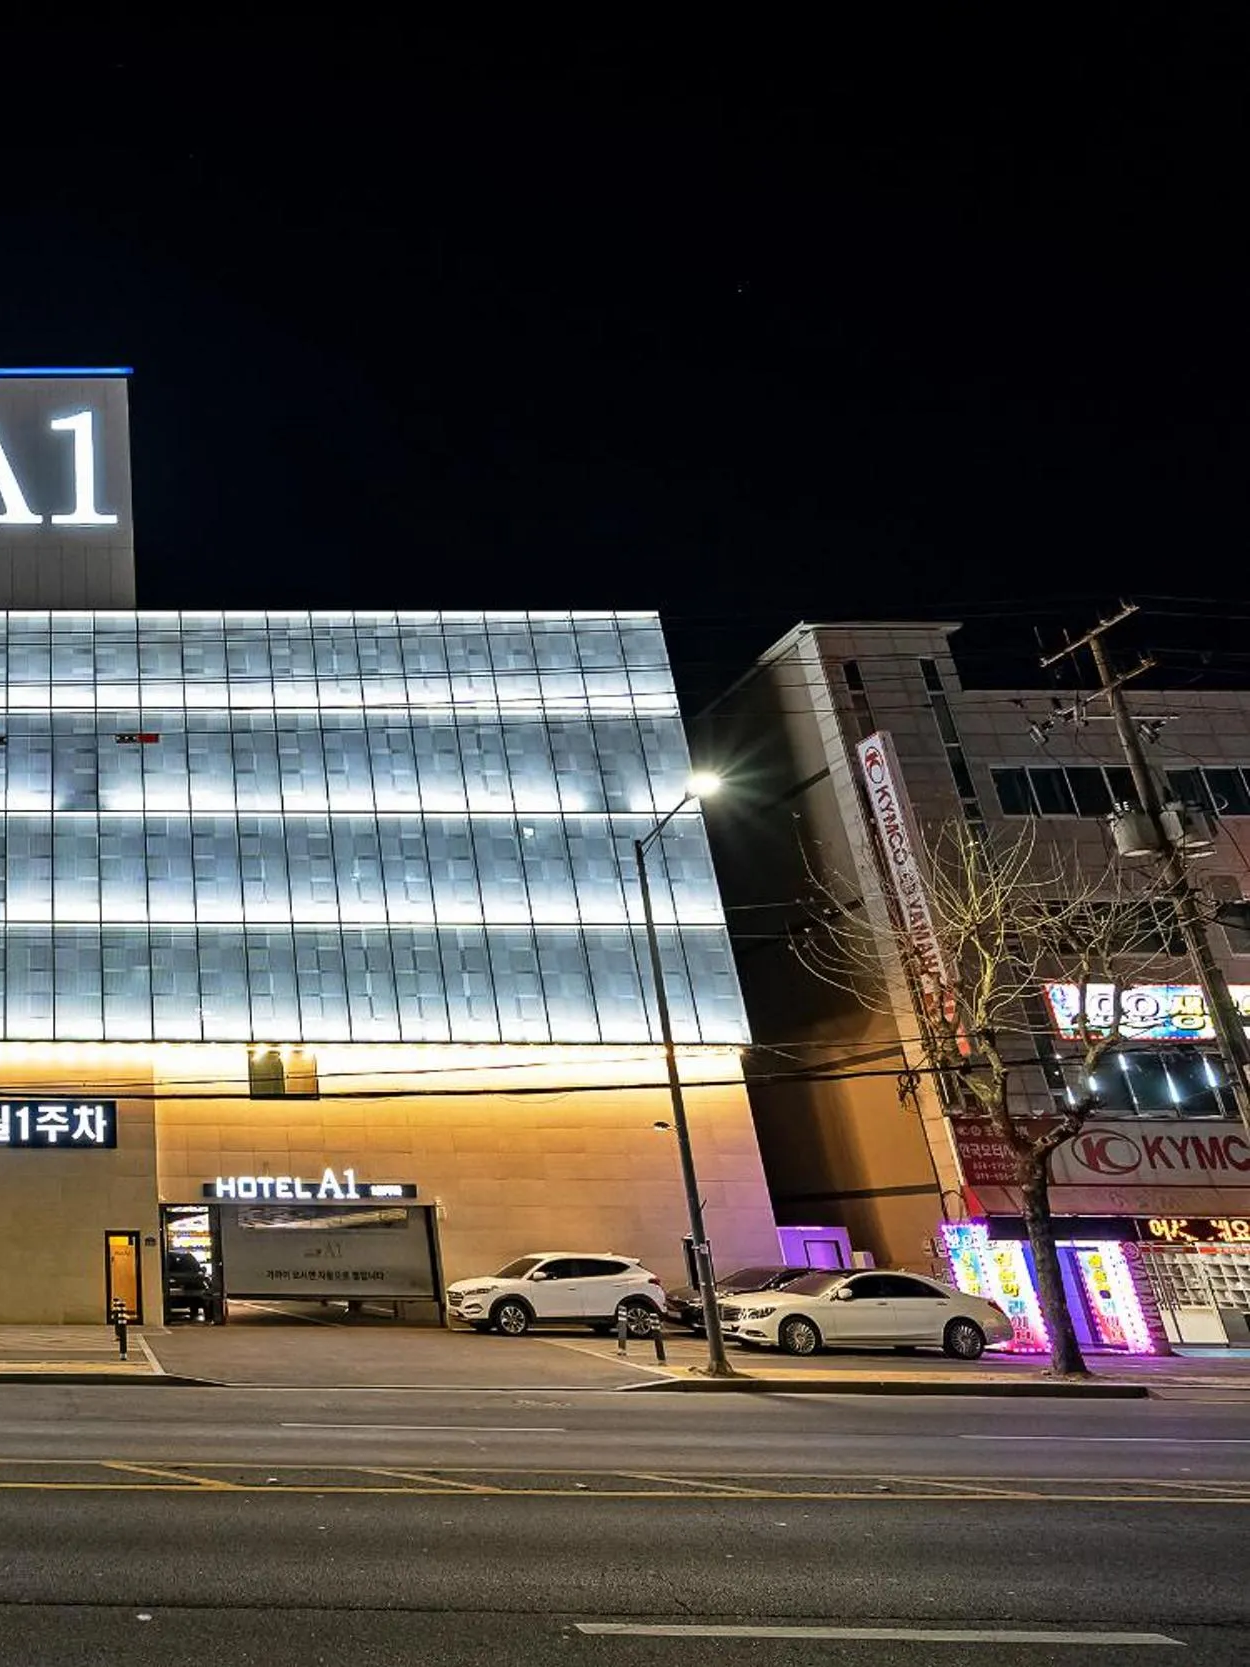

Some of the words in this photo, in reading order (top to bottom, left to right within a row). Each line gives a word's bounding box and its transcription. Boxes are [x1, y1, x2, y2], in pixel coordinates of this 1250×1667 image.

[875, 784, 909, 866] KYMCO
[216, 1176, 312, 1199] HOTEL
[316, 1167, 361, 1200] A1
